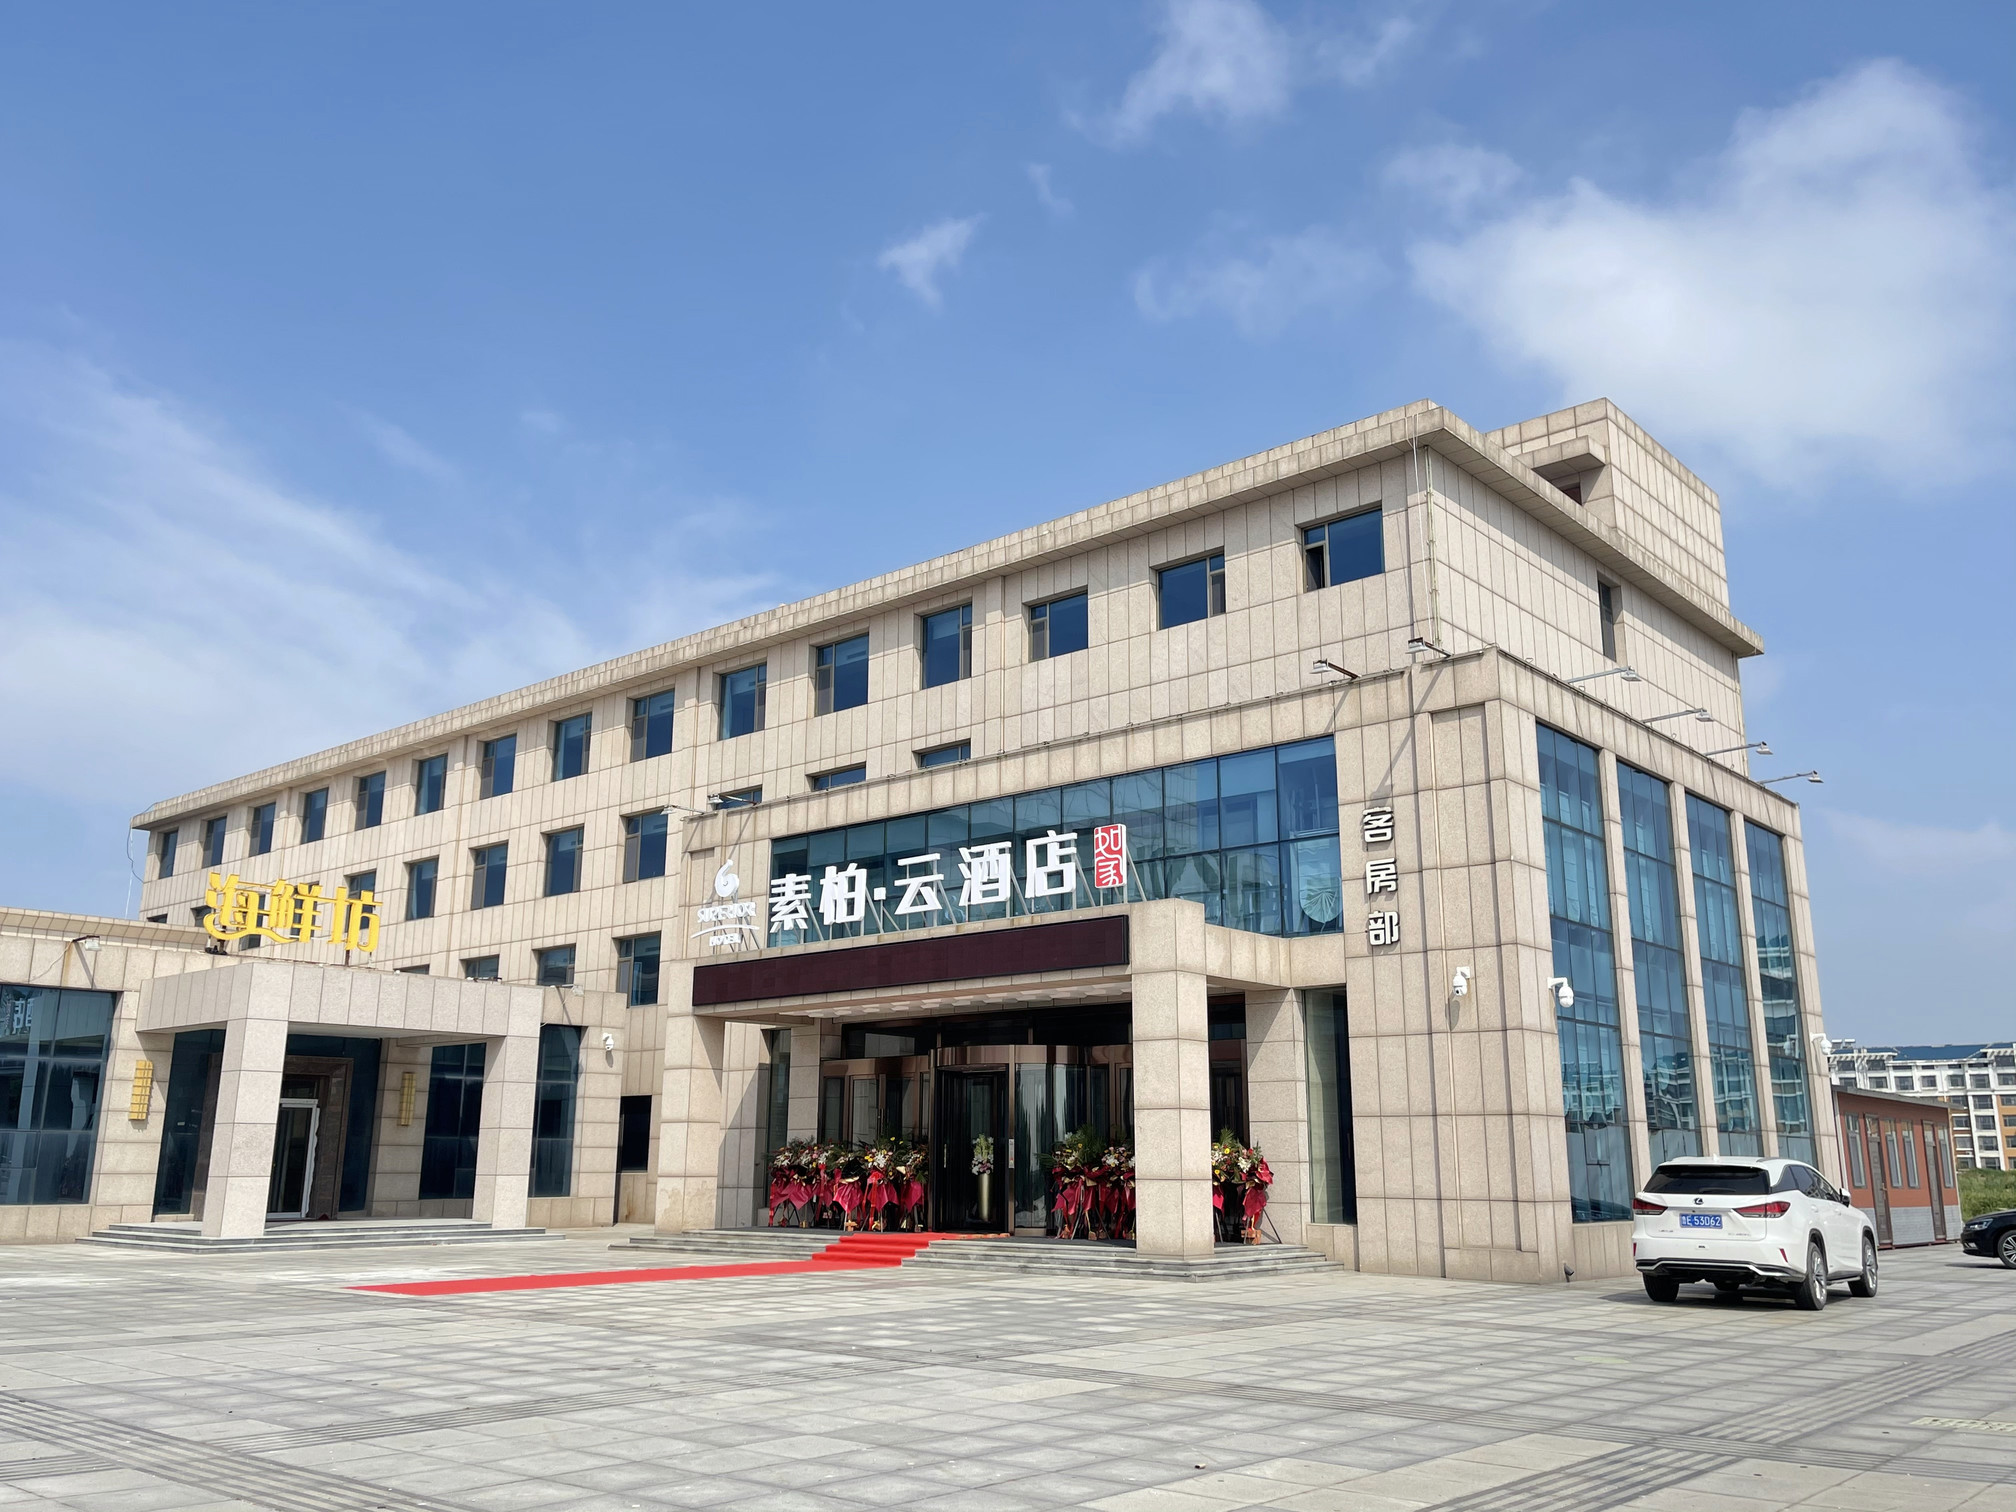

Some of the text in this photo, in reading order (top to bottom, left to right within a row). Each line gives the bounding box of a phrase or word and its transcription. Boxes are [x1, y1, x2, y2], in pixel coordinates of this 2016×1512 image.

[768, 829, 1078, 934] 素柏·云酒店
[1094, 824, 1126, 888] 如家
[1363, 806, 1399, 945] 客房部
[203, 872, 384, 953] 海鲜坊
